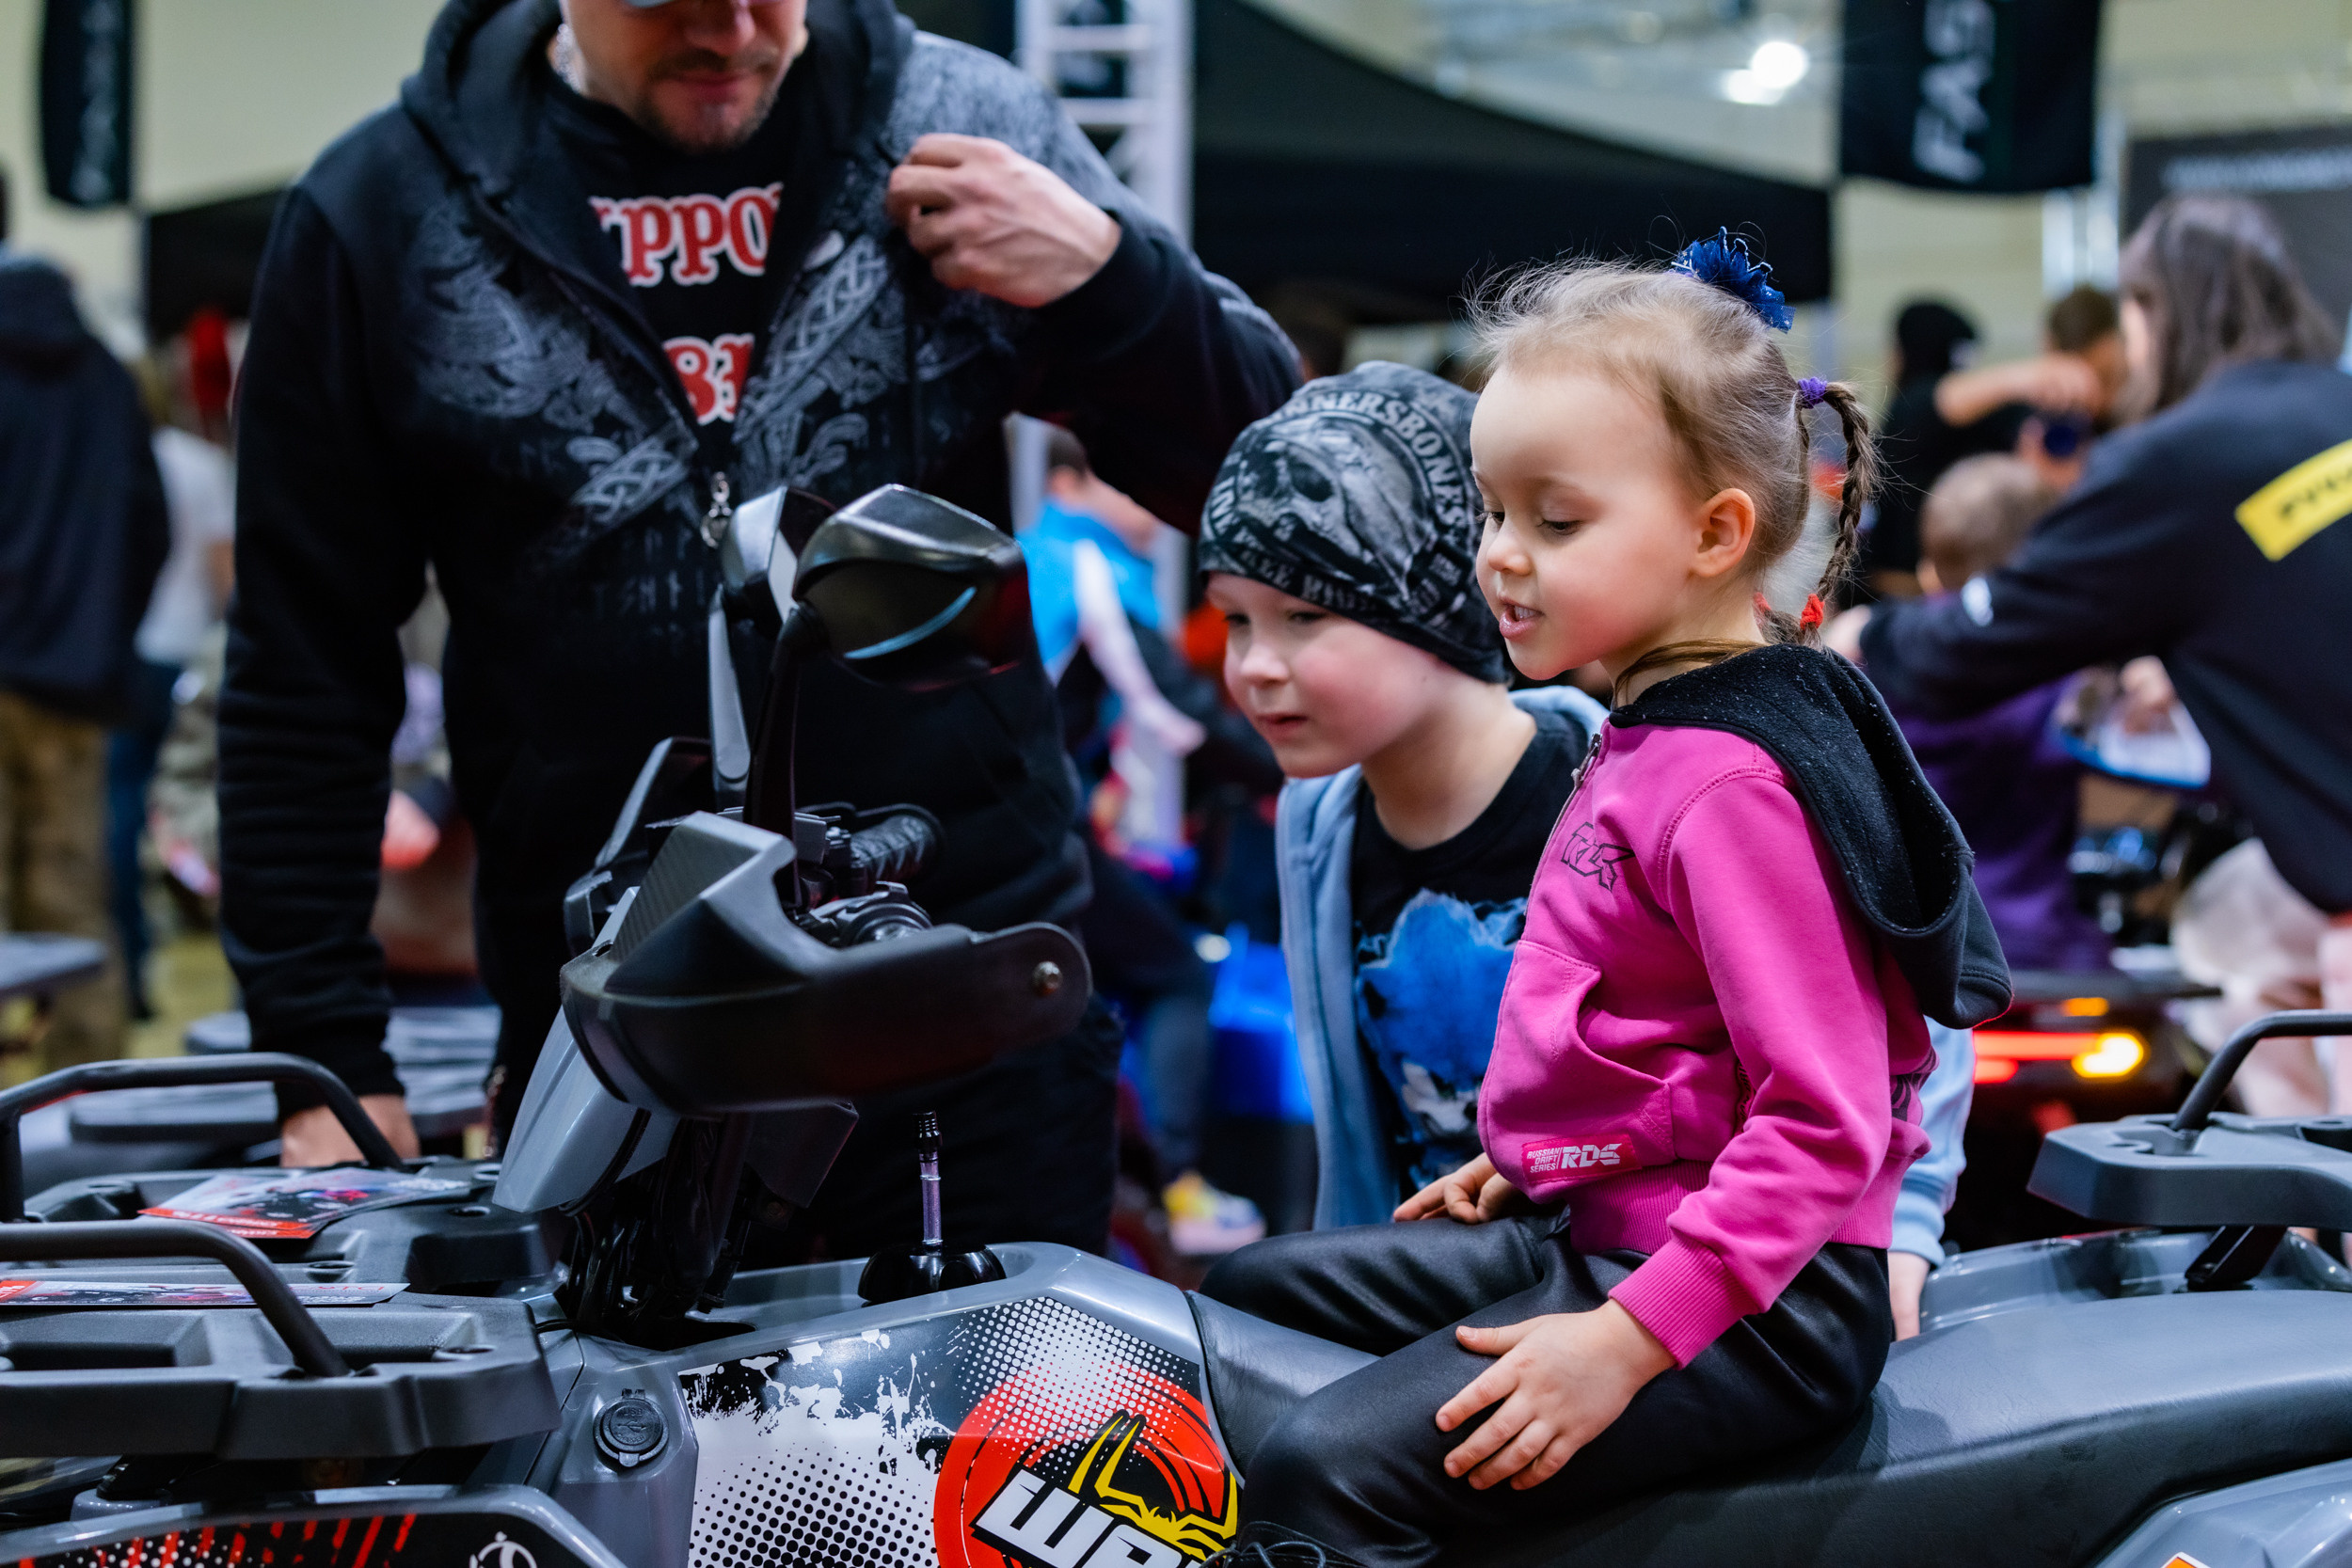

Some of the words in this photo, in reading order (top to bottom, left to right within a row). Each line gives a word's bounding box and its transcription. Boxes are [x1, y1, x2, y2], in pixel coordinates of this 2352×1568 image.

[1526, 1147, 1560, 1160] RUSSIAN
[1561, 1142, 1622, 1169] RDS
[1534, 1154, 1558, 1165] DRIFT
[1530, 1163, 1557, 1174] SERIES
[623, 1407, 644, 1417] USB
